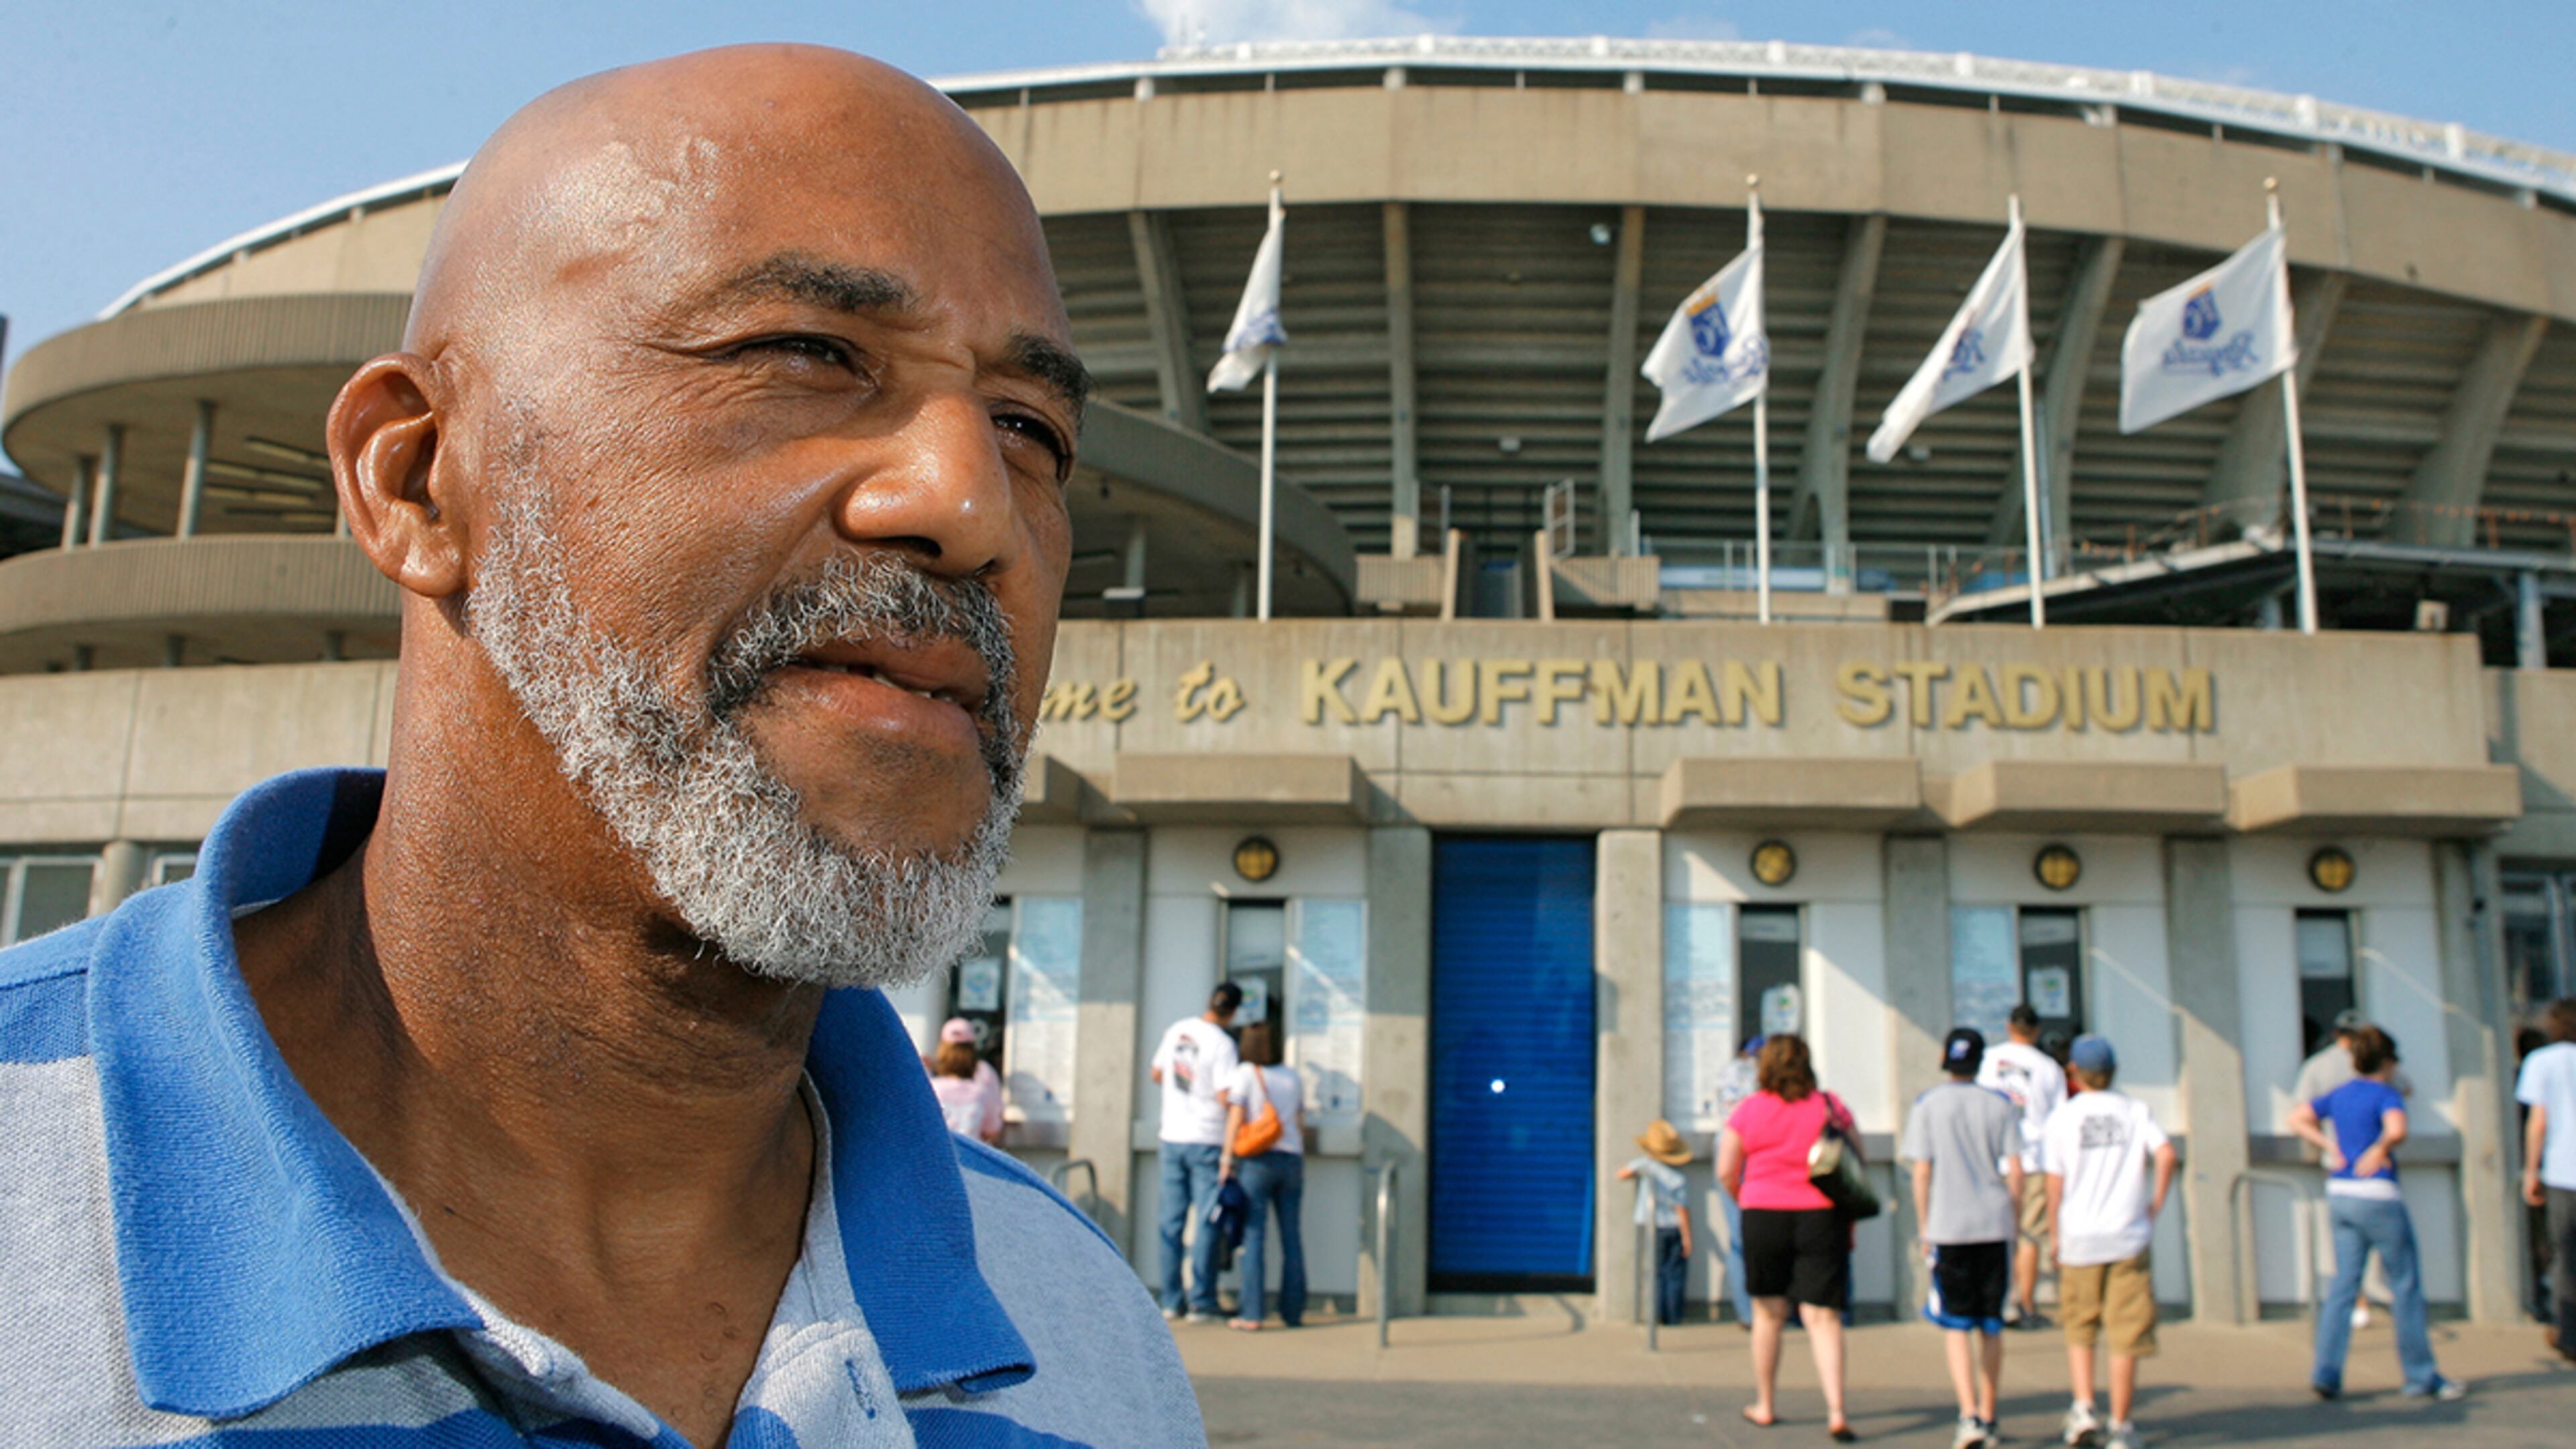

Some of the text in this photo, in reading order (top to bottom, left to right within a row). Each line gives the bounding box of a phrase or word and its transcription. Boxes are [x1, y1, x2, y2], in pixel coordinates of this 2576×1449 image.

[1175, 659, 1244, 722] to
[1300, 657, 1782, 727] KAUFFMAN
[1835, 659, 2215, 731] STADIUM
